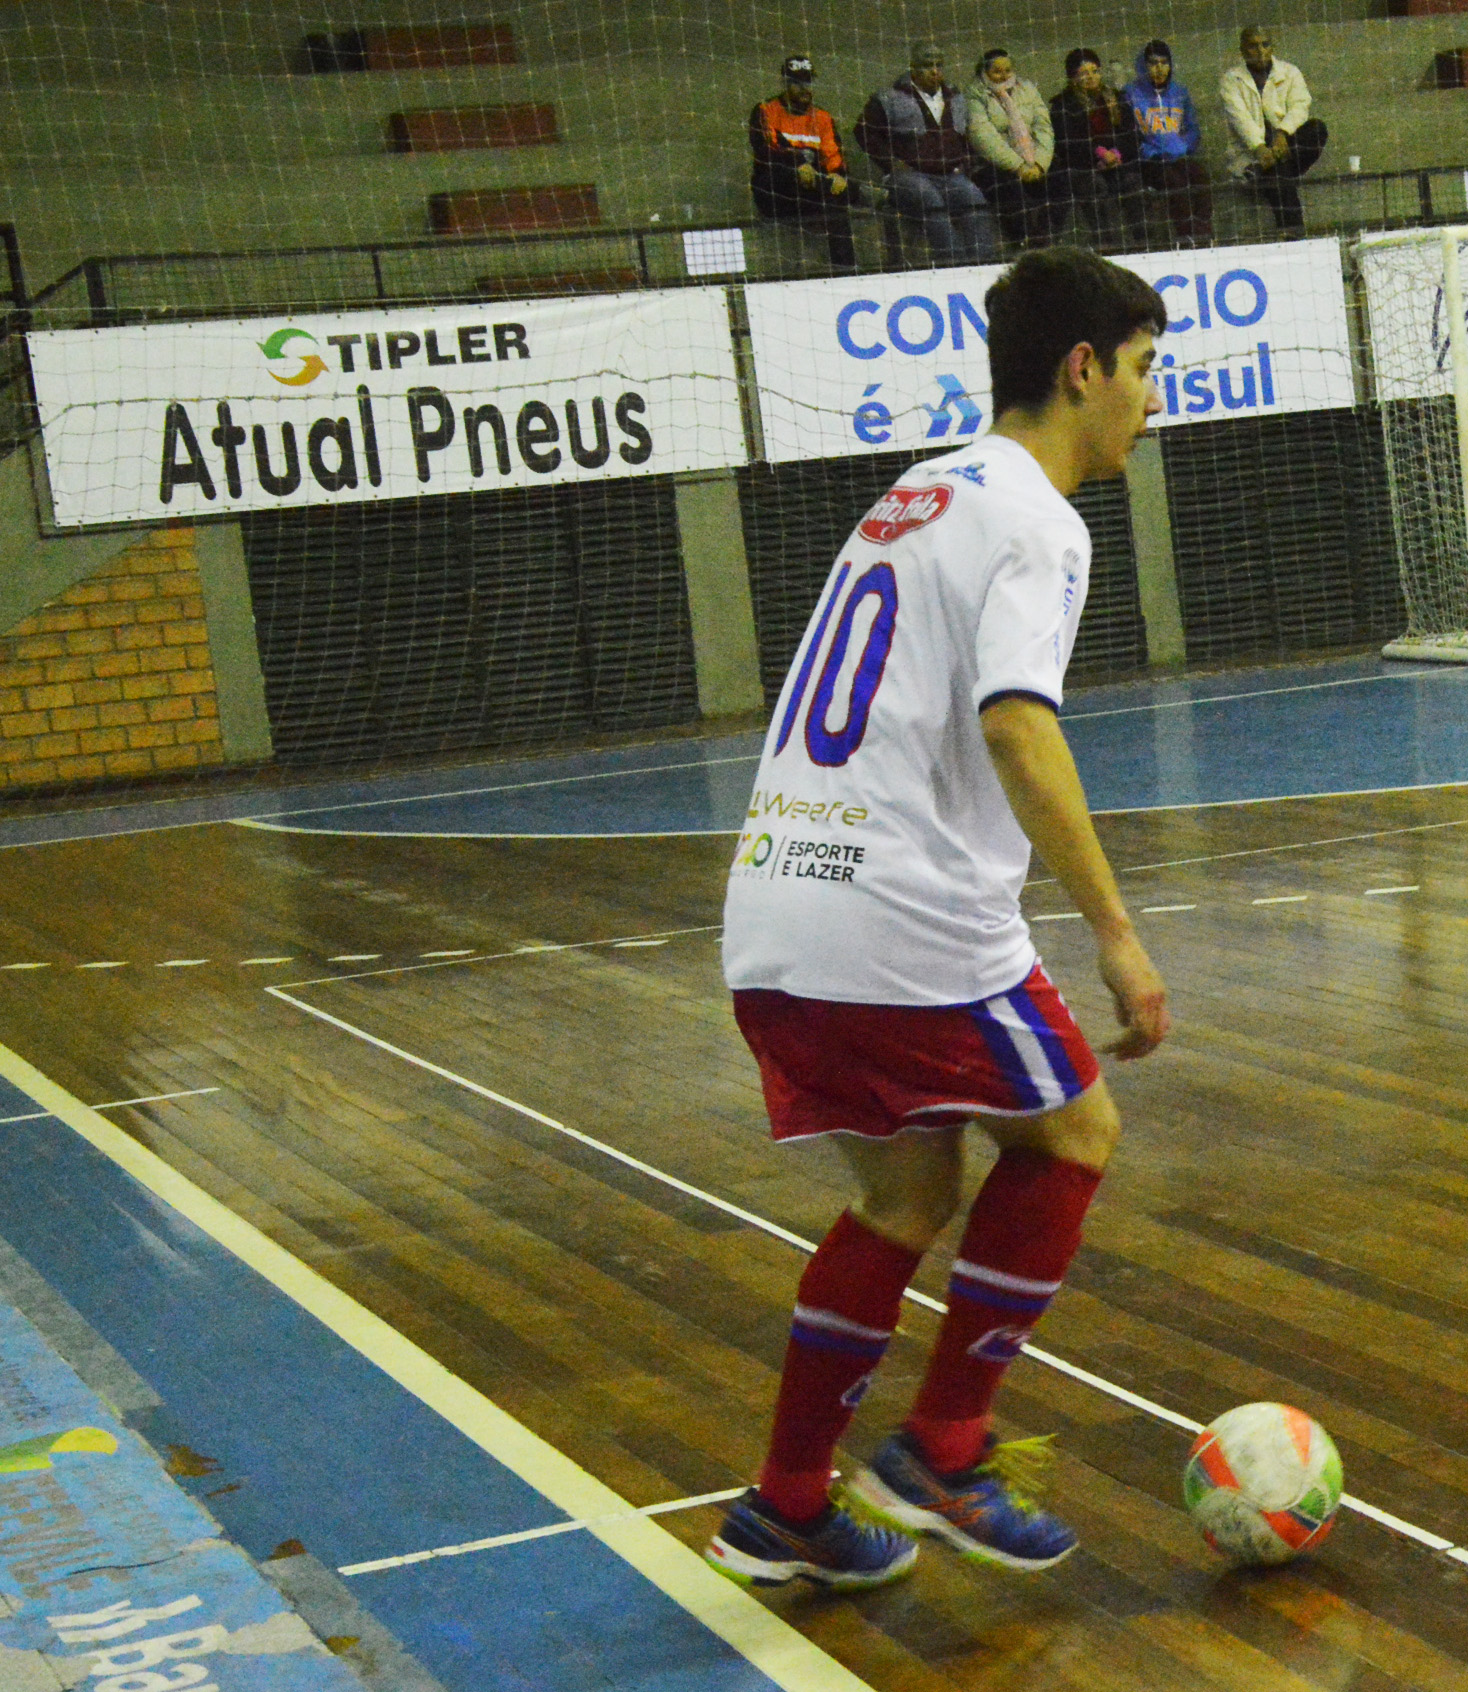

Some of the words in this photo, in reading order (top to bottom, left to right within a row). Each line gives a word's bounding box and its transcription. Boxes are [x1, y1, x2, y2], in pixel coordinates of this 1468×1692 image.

[328, 322, 531, 373] TIPLER
[852, 382, 894, 445] é
[159, 384, 383, 504] Atual
[406, 385, 653, 484] Pneus
[773, 561, 899, 768] 10
[781, 860, 792, 876] E
[795, 860, 856, 883] LAZER
[787, 840, 866, 864] ESPORTE
